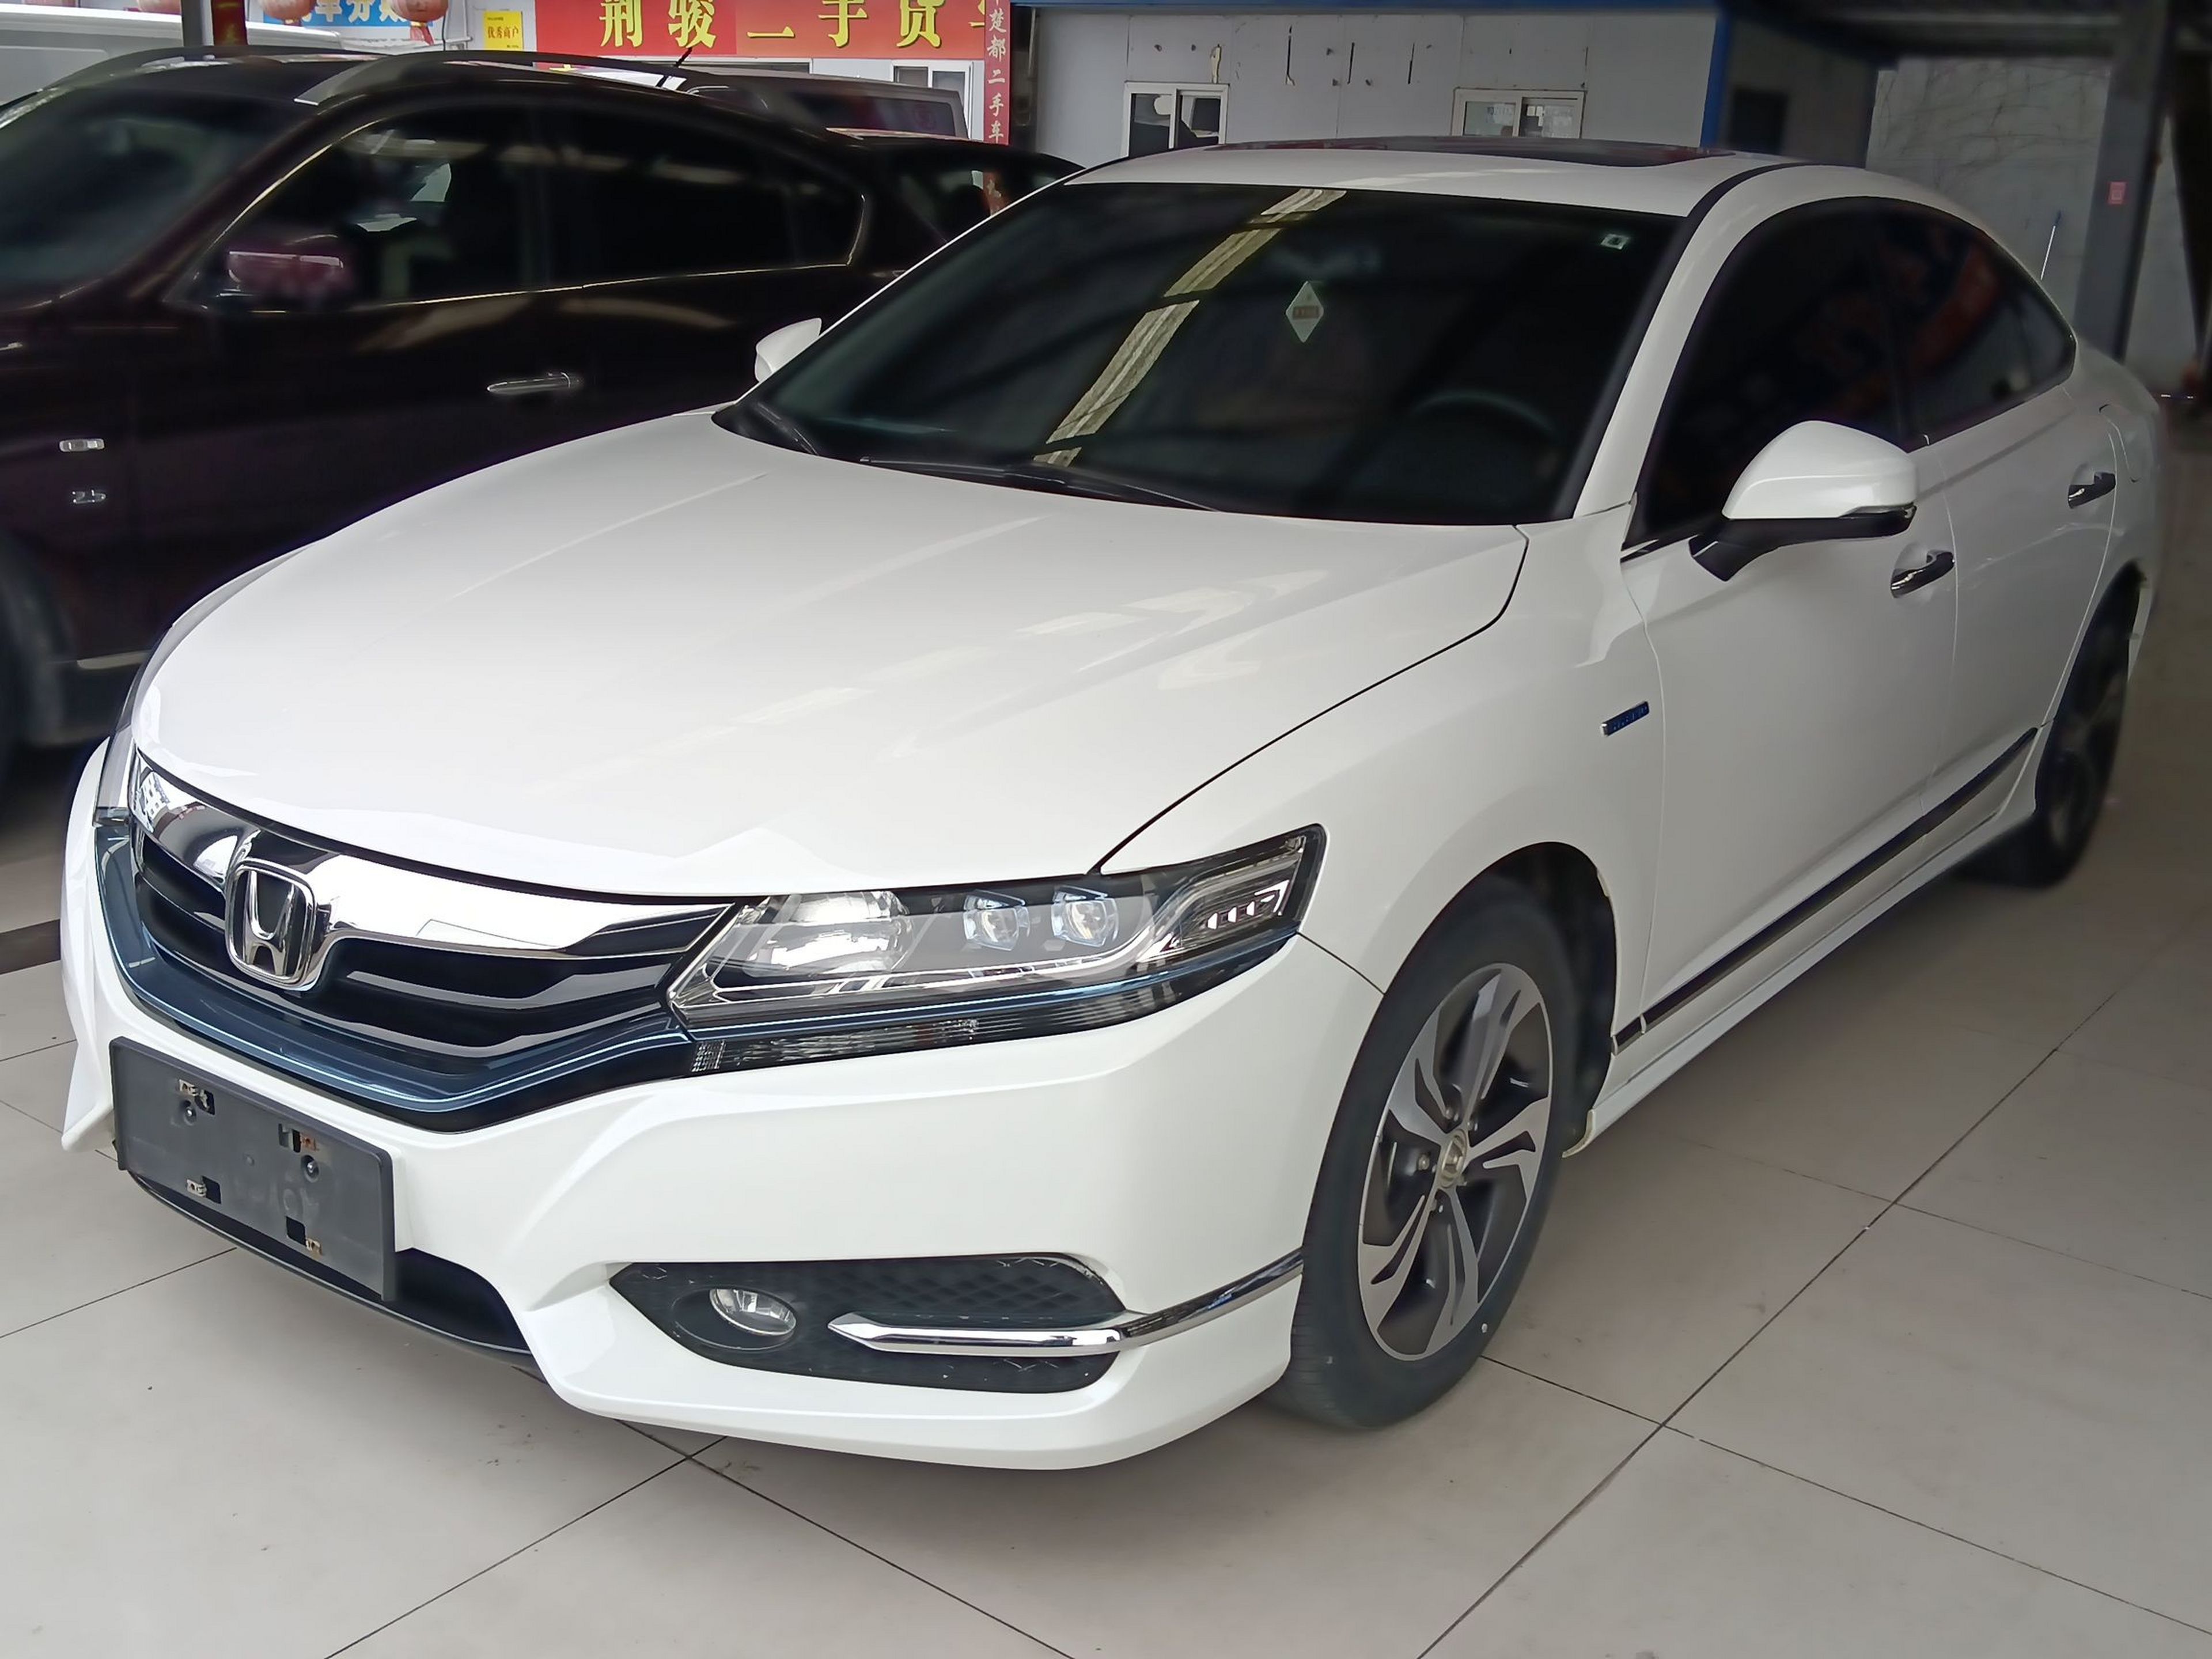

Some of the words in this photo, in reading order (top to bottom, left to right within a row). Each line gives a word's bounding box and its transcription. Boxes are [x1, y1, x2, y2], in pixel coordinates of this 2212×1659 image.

[986, 0, 1006, 143] 楚都二手车
